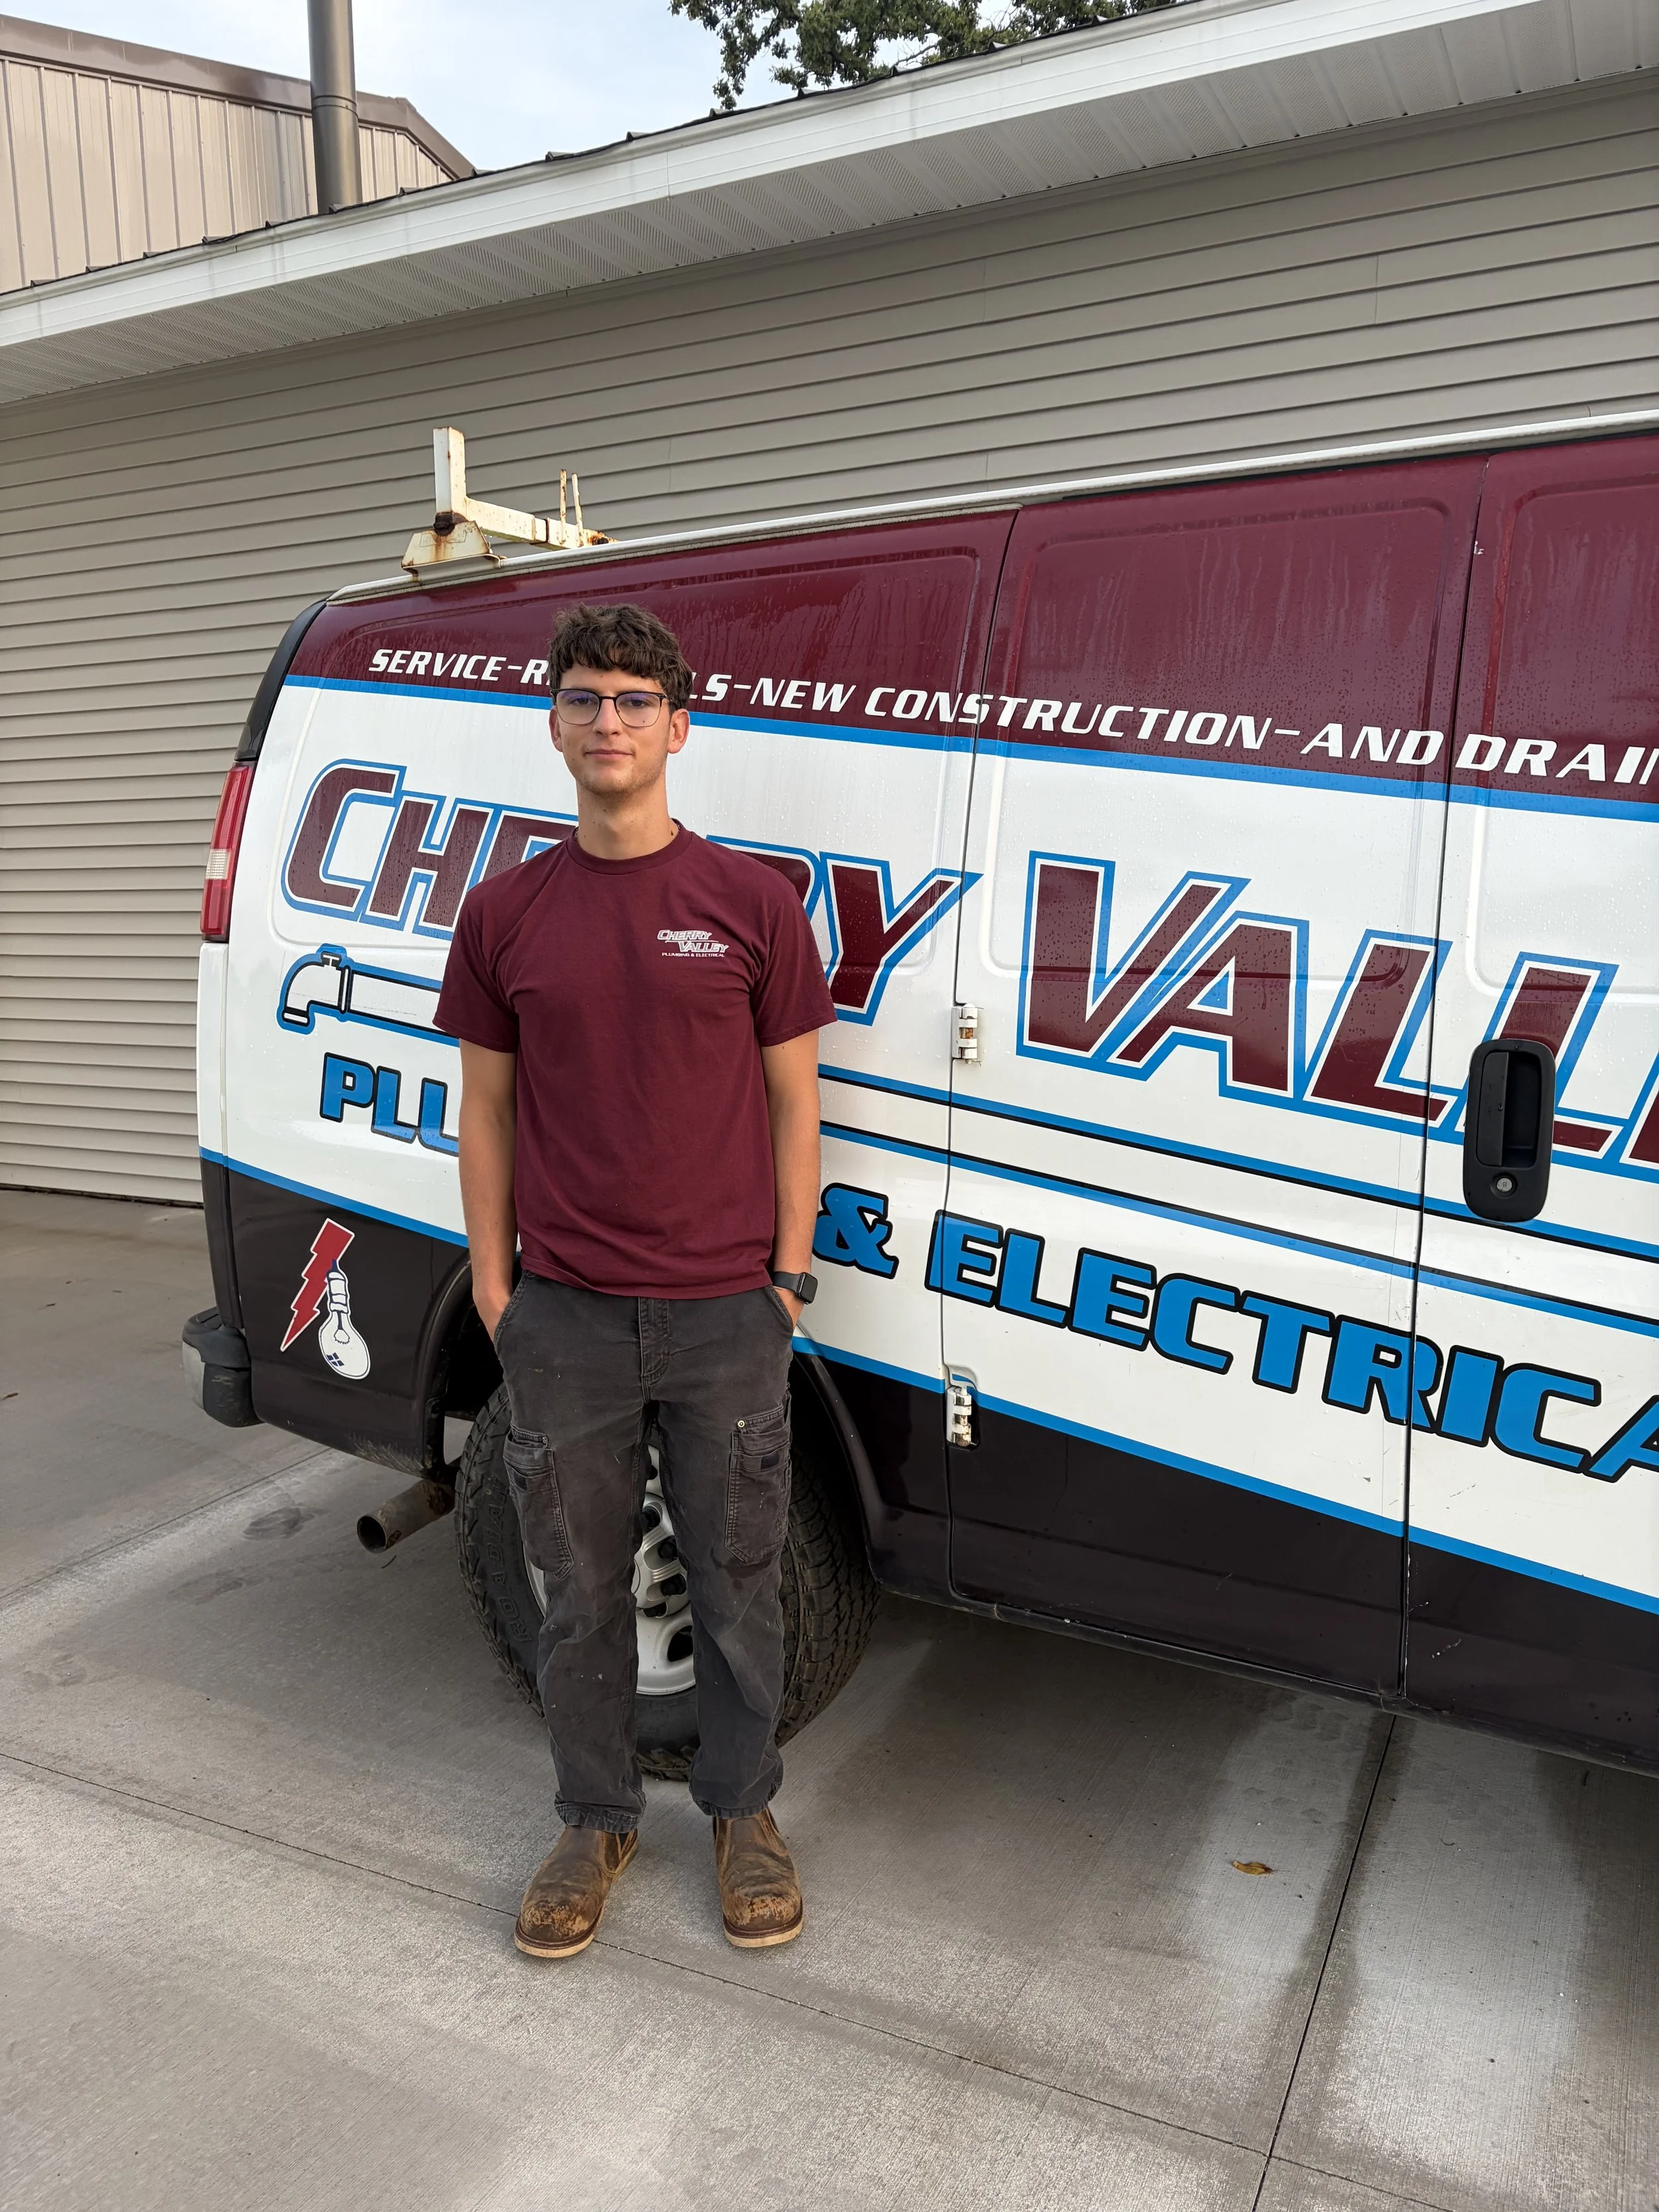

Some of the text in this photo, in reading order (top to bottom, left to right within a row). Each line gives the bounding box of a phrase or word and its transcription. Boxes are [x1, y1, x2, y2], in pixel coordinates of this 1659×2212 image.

[1455, 733, 1659, 785] DRAI
[657, 930, 712, 940] CHERRY
[678, 941, 729, 953] VALLEY
[281, 758, 1659, 1185] CHY VALL
[812, 1183, 899, 1280] &
